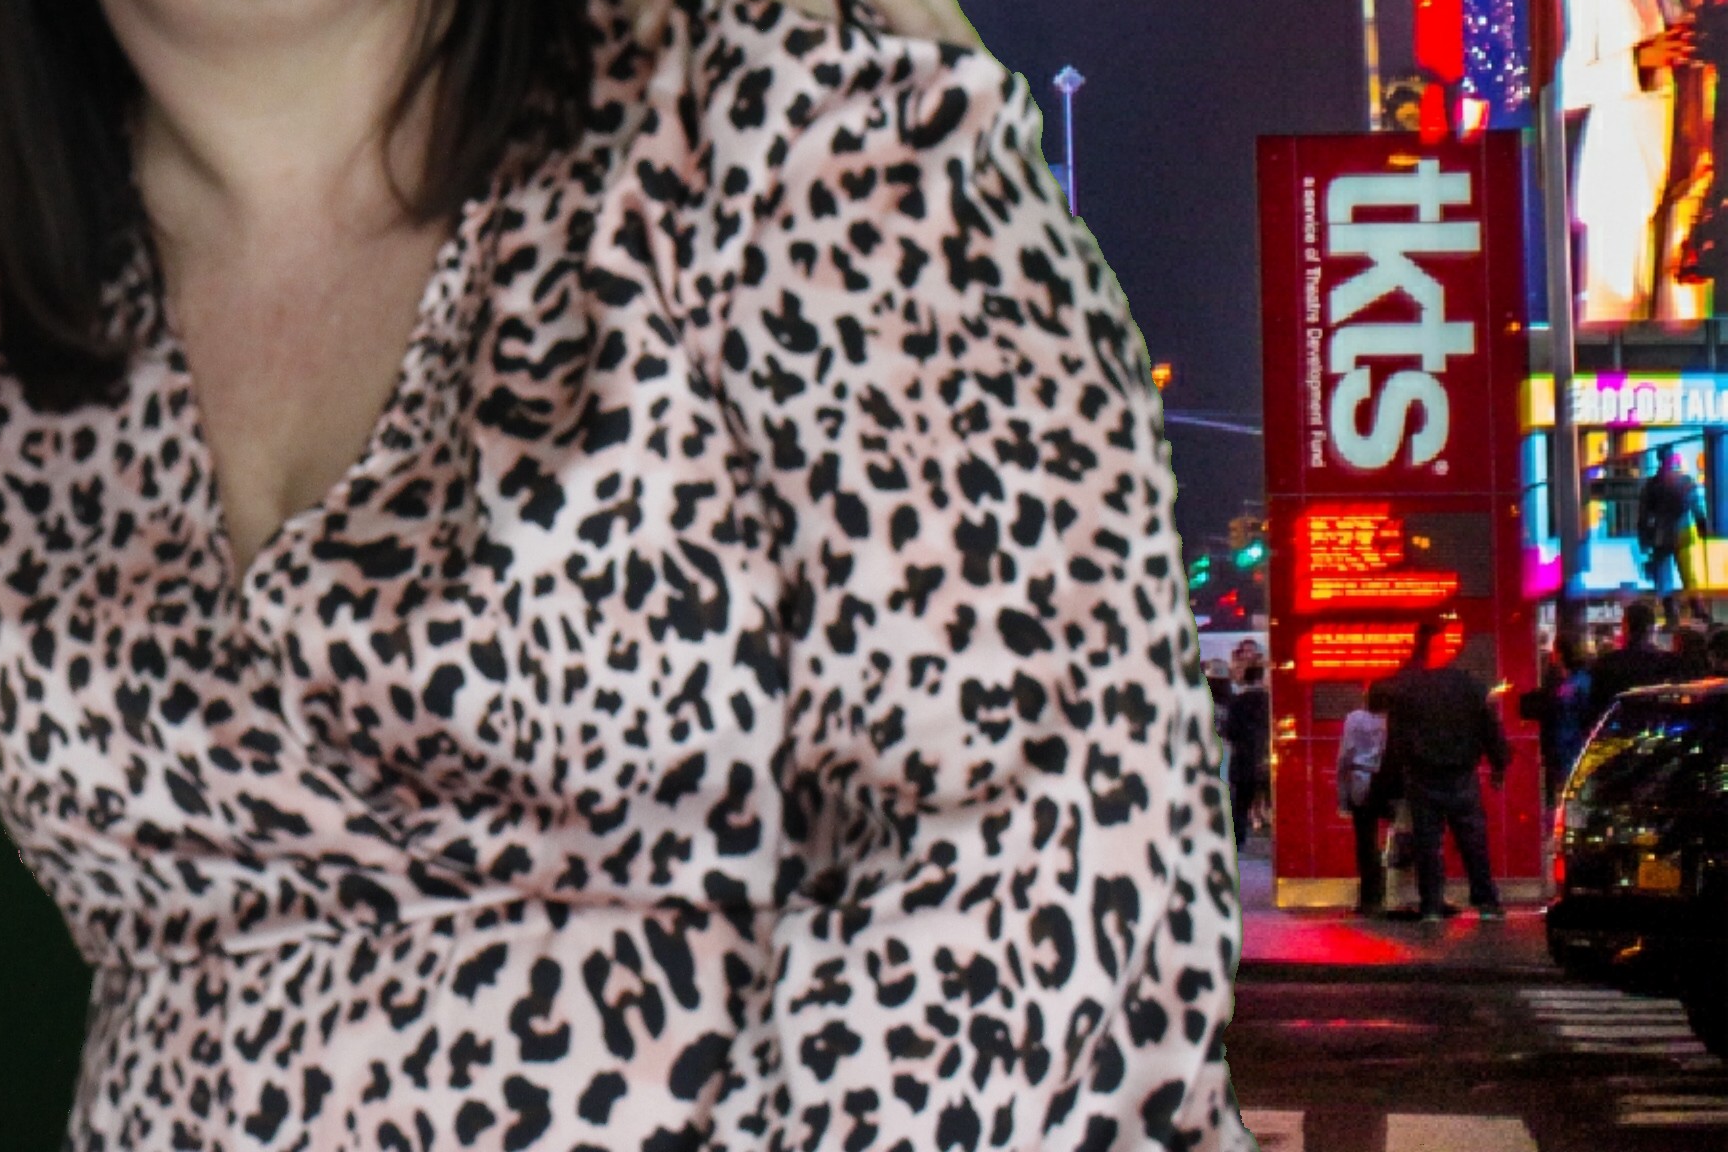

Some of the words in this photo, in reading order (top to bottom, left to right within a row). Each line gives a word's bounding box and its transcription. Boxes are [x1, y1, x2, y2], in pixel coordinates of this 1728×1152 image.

[1304, 188, 1318, 243] service
[1326, 158, 1481, 470] tkts
[1305, 328, 1324, 426] Development
[1310, 429, 1326, 468] Fund
